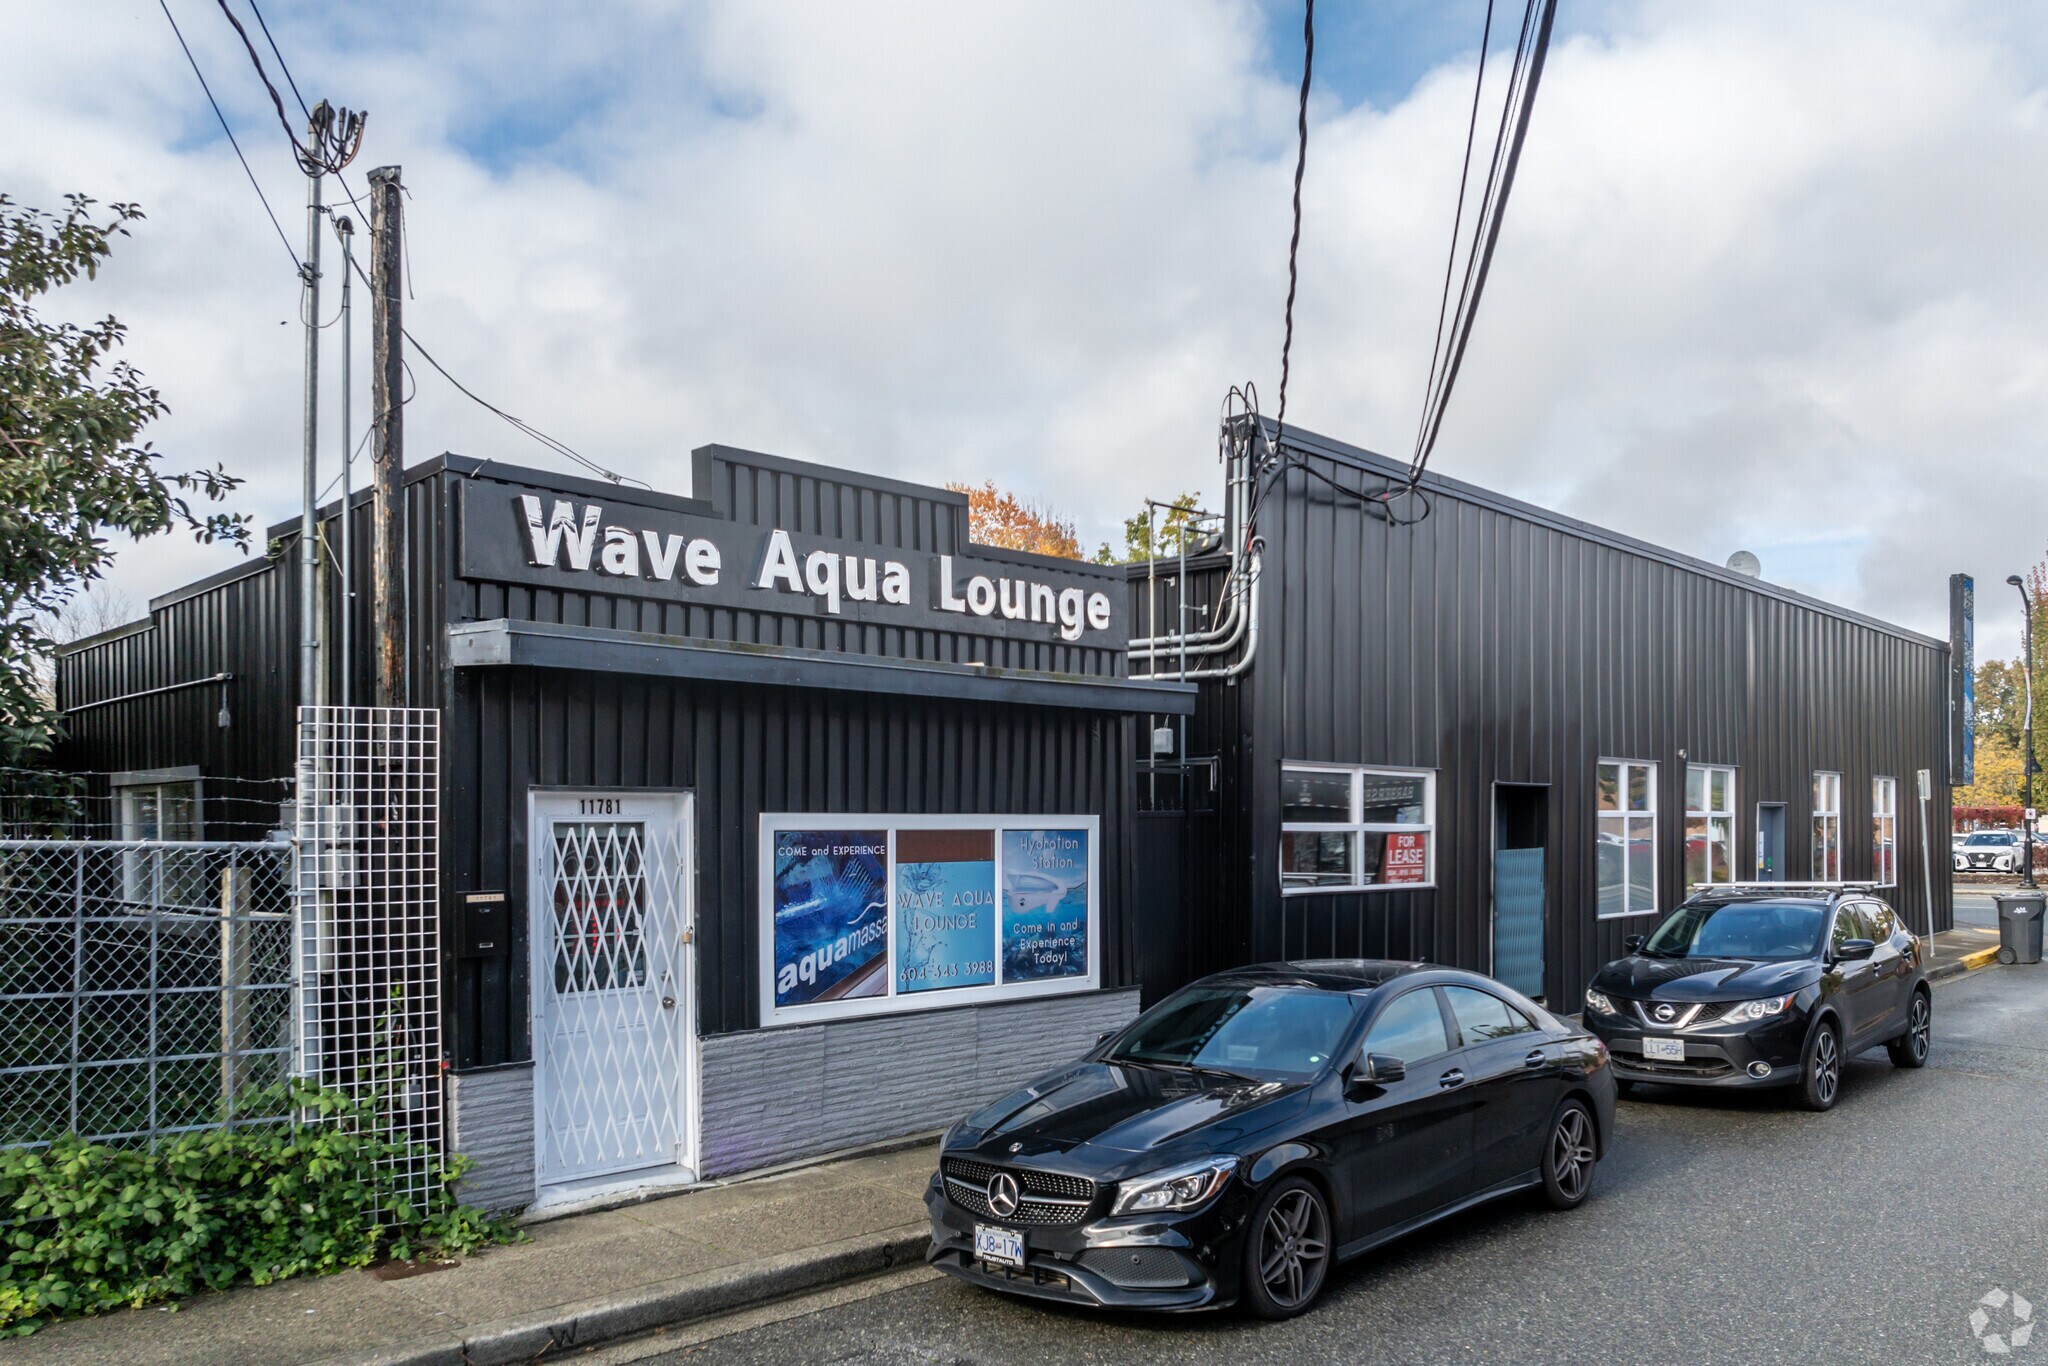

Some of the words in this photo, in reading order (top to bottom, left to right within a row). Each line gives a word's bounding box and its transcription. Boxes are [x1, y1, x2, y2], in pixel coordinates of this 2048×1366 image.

[519, 494, 722, 586] Wave
[756, 529, 912, 615] Aqua
[939, 555, 1111, 642] Lounge
[580, 799, 620, 815] 11781
[1020, 834, 1079, 855] Hydration
[1398, 835, 1416, 847] FOR
[778, 846, 807, 857] COME
[811, 844, 830, 856] and
[833, 845, 886, 856] EXPERIENCE
[1389, 848, 1423, 864] LEASE
[1032, 854, 1074, 870] Station
[899, 891, 945, 909] WAVE
[951, 889, 995, 907] AQUA
[914, 912, 977, 932] LOUNGE
[1013, 923, 1043, 935] Come
[1060, 917, 1078, 931] and
[1020, 937, 1075, 954] Experience
[1034, 951, 1068, 967] Today!
[899, 966, 927, 982] 604
[964, 959, 995, 976] 3988
